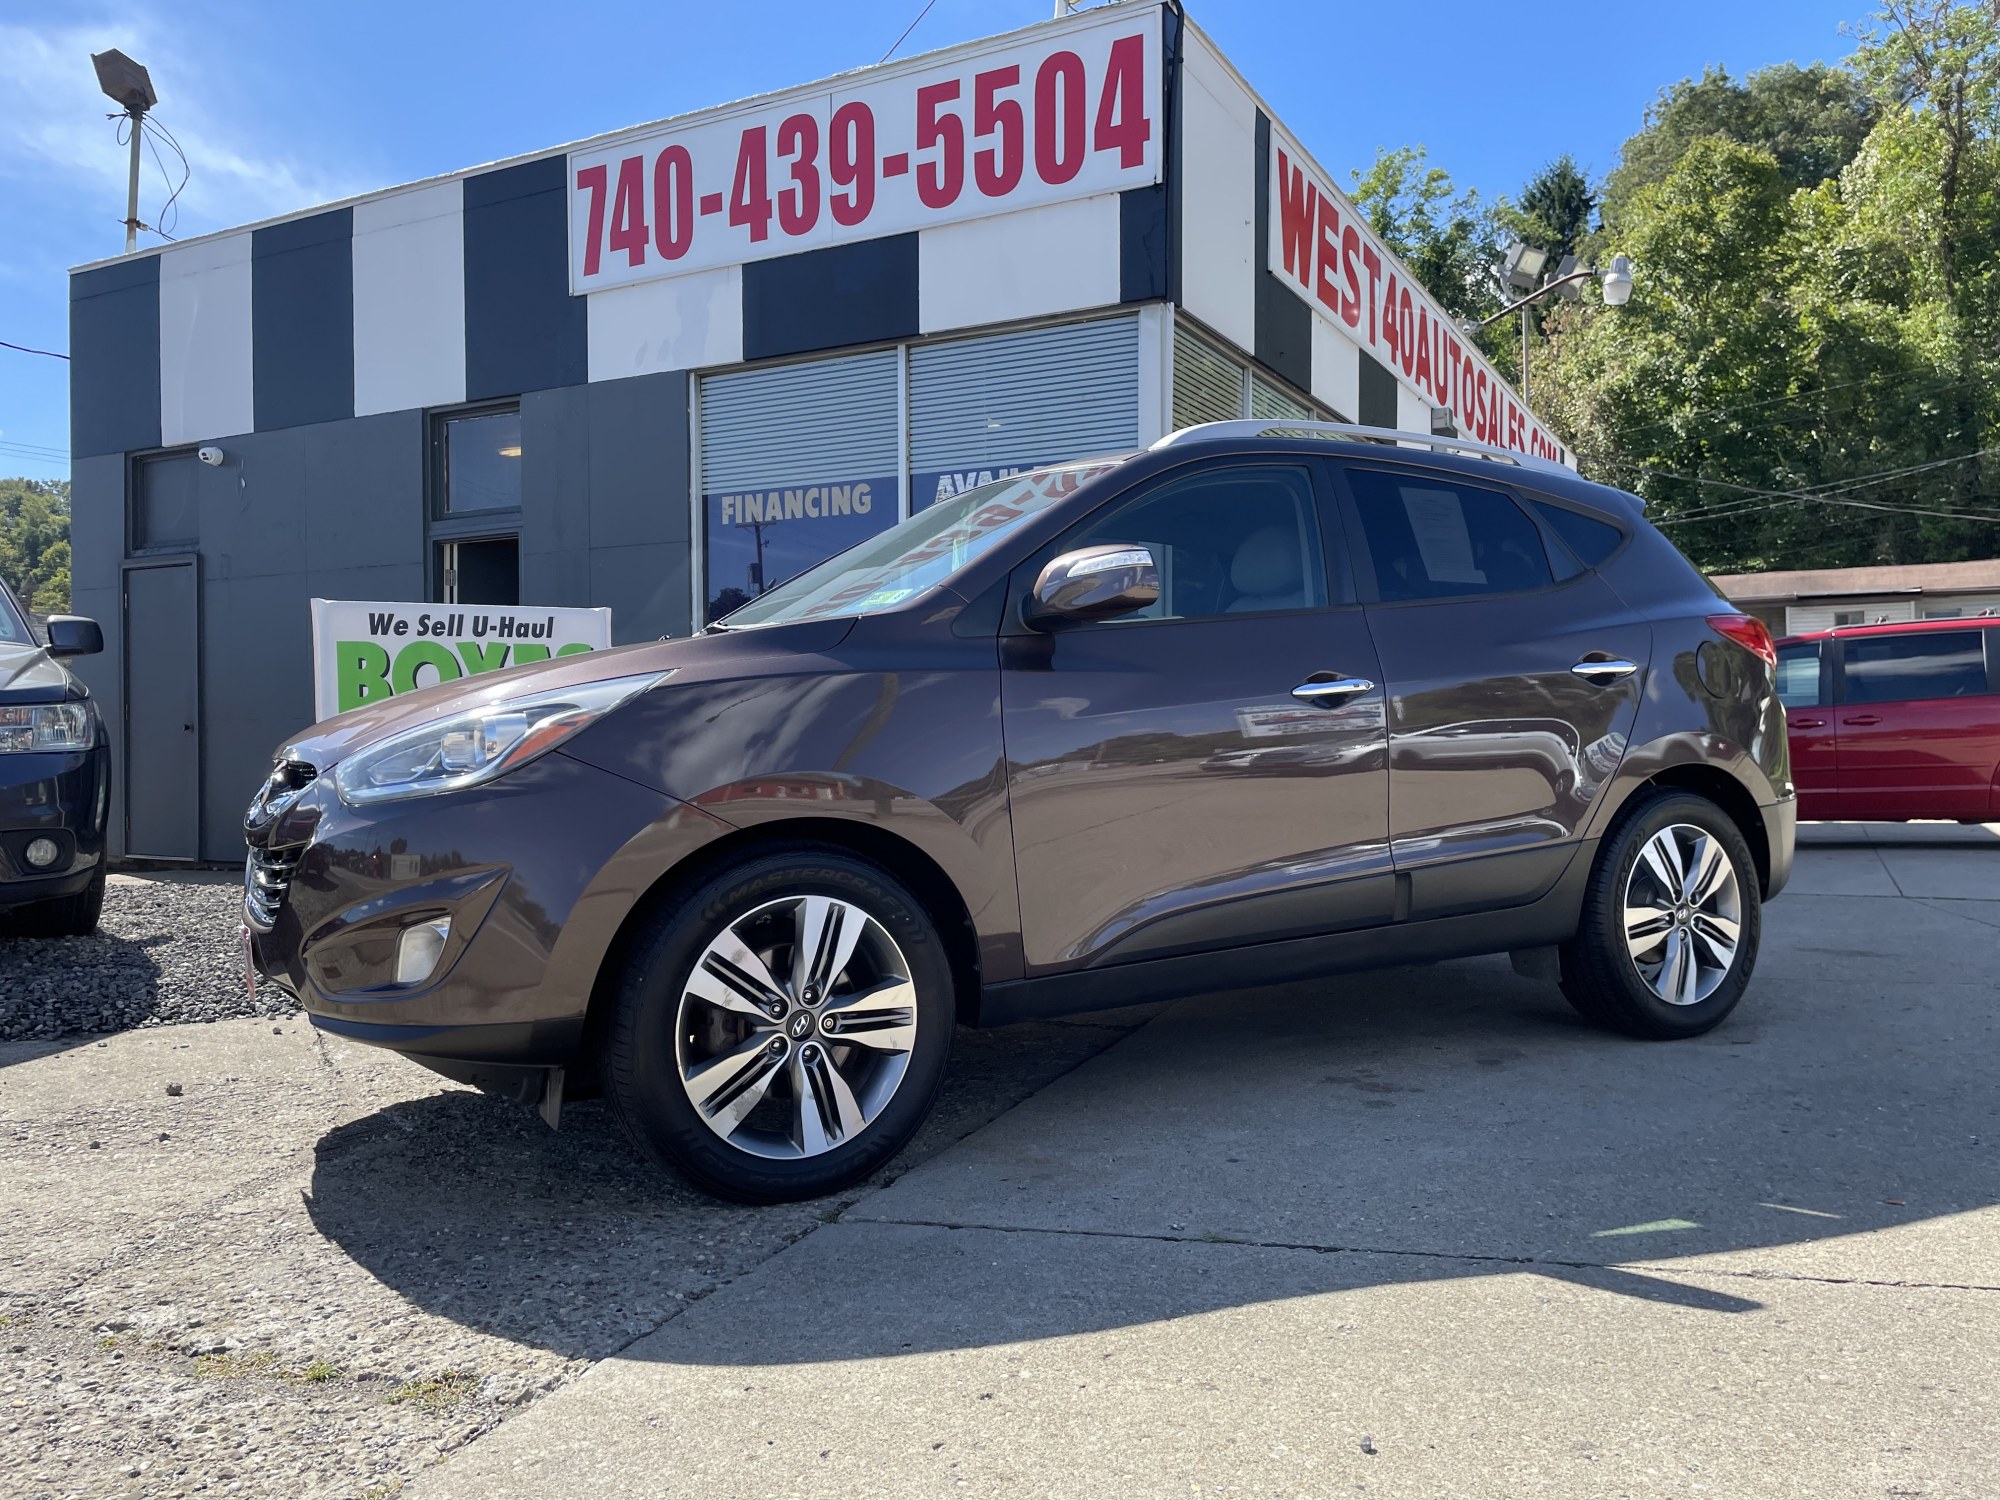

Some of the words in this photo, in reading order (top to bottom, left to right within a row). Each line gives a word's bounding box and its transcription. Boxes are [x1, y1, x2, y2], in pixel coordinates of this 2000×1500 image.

[577, 34, 1150, 277] 740-439-5504
[1277, 146, 1557, 462] WEST40AUTOSALES
[721, 483, 872, 526] FINANCING
[368, 613, 408, 636] We
[416, 613, 464, 637] Sell
[472, 615, 555, 638] U-Haul
[728, 867, 913, 922] MASTERCRAFT
